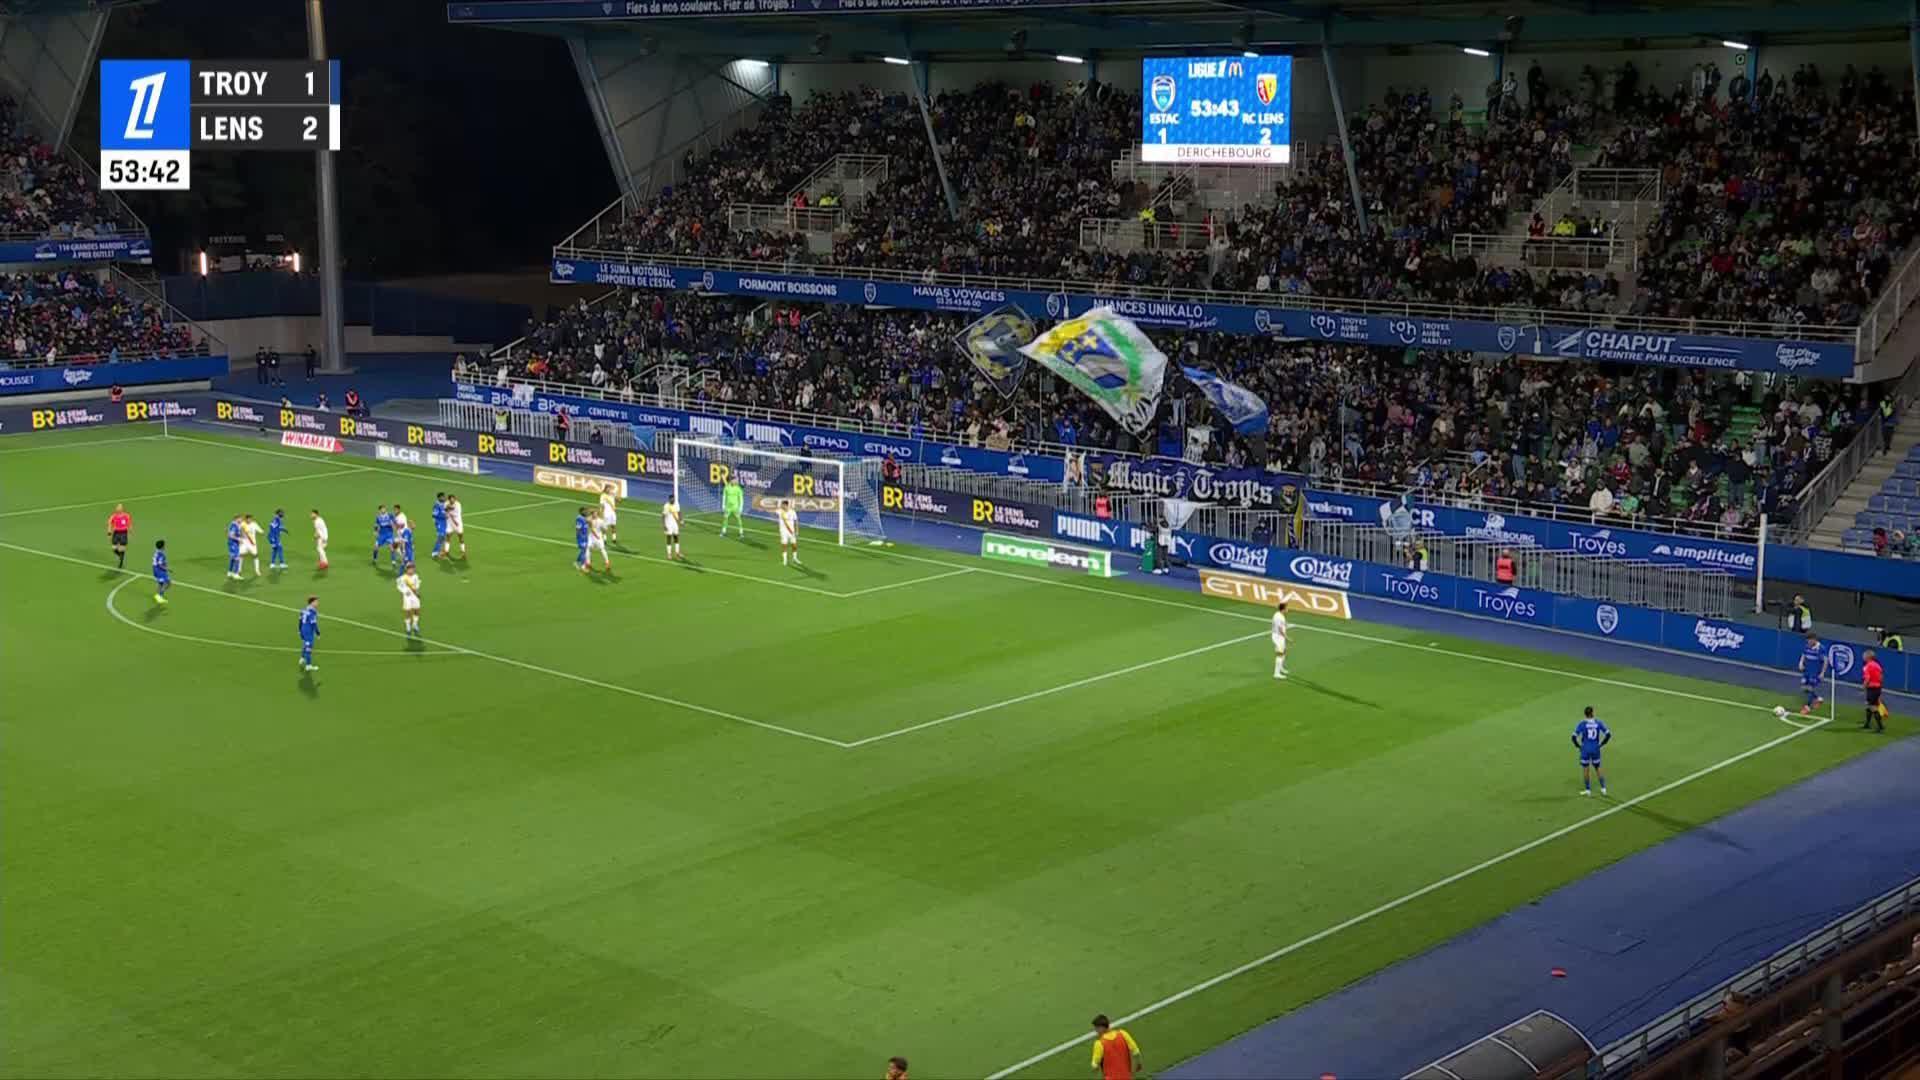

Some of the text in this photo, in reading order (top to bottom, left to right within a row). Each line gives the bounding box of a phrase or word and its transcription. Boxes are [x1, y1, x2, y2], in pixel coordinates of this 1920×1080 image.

[1190, 99, 1240, 118] 53:43
[1149, 113, 1179, 125] ESTAC
[1242, 113, 1284, 125] RC LENS
[1158, 127, 1168, 145] 1
[1260, 127, 1272, 145] 2
[1177, 147, 1272, 159] DERICHEBOURG
[596, 273, 636, 286] SUPPORTER
[637, 276, 648, 287] DE
[600, 263, 672, 278] LE SUMA MOTOBALL
[738, 277, 838, 297] FORMONT BOISSONS
[913, 286, 1006, 302] HAVAS VOYAGES
[1148, 302, 1204, 319] UNIKALO
[1586, 331, 1676, 353] CHAPUT
[1585, 349, 1737, 367] LE PEINTRE PAR EXCELLENCE
[32, 409, 55, 429] BR
[126, 401, 148, 420] BR
[217, 401, 233, 420] BR
[280, 409, 295, 428] BR
[588, 406, 619, 419] CENTURY
[639, 413, 672, 426] CENTURY
[340, 417, 356, 436] BR
[689, 415, 723, 434] PUMA
[745, 422, 780, 443] PUMA
[285, 431, 333, 452] WINAMAX
[407, 425, 424, 445] BR
[478, 434, 496, 454] BR
[803, 434, 849, 450] ETIHAD
[391, 447, 470, 469] LCR LCR
[550, 443, 567, 463] BR
[864, 442, 912, 458] ETIHAD
[627, 452, 646, 473] BR
[536, 471, 618, 495] ETIHAD
[710, 463, 729, 486] BR
[793, 473, 814, 496] BR
[1107, 461, 1275, 509] Magic Troyes
[883, 485, 903, 509] BR
[972, 499, 993, 524] BR
[1410, 508, 1435, 527] CR
[1057, 514, 1101, 541] PUMA
[1465, 526, 1536, 546] DERICHEBOURG
[1568, 531, 1627, 556] Troyes
[986, 541, 1100, 571] norelem
[1673, 546, 1755, 566] amplitude
[1206, 576, 1339, 613] ETIHAD
[1381, 573, 1439, 602] Troyes
[1474, 589, 1536, 619] Troyes
[1587, 727, 1598, 740] 10
